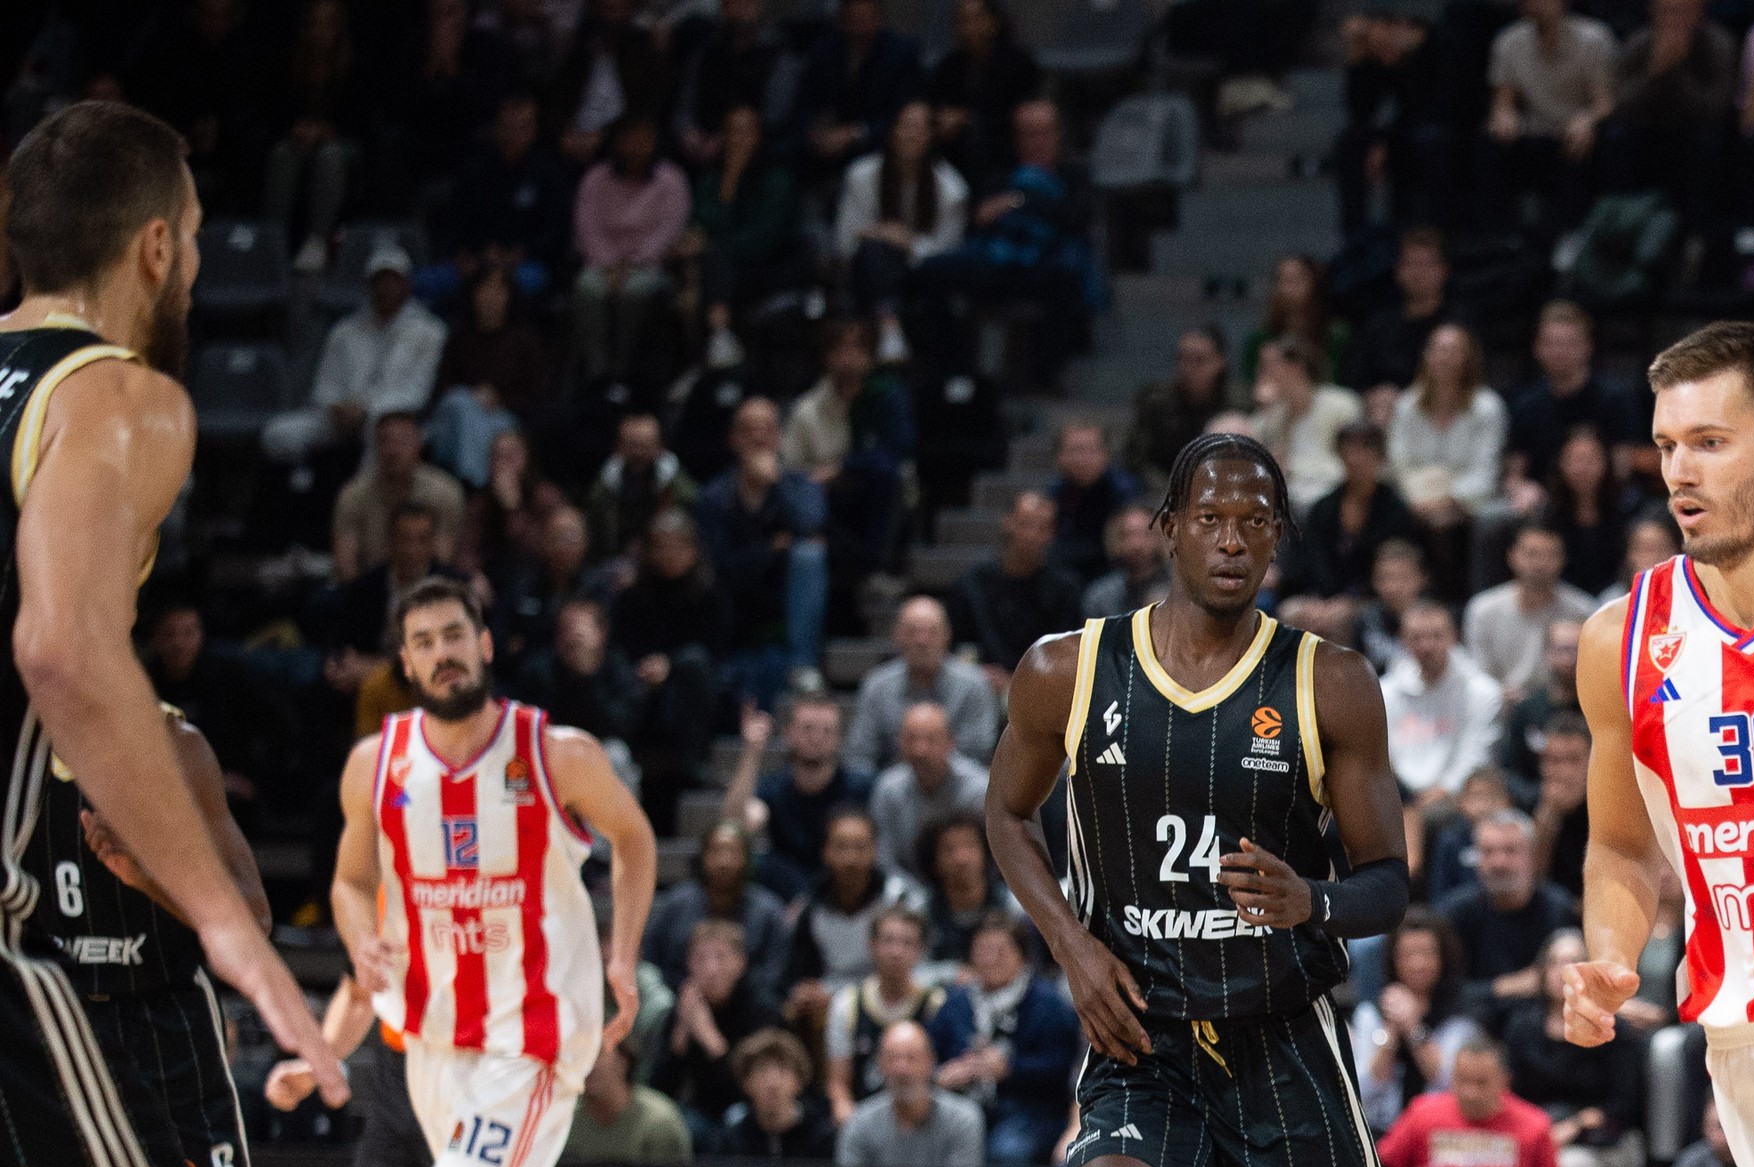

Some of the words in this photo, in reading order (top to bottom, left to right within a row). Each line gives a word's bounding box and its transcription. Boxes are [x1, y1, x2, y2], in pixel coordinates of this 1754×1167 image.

[1241, 757, 1290, 772] oneteam
[441, 819, 479, 866] 12
[1156, 814, 1222, 883] 24
[55, 860, 84, 918] 6
[412, 876, 526, 908] meridian
[431, 917, 511, 956] mts
[466, 1115, 512, 1167] 12
